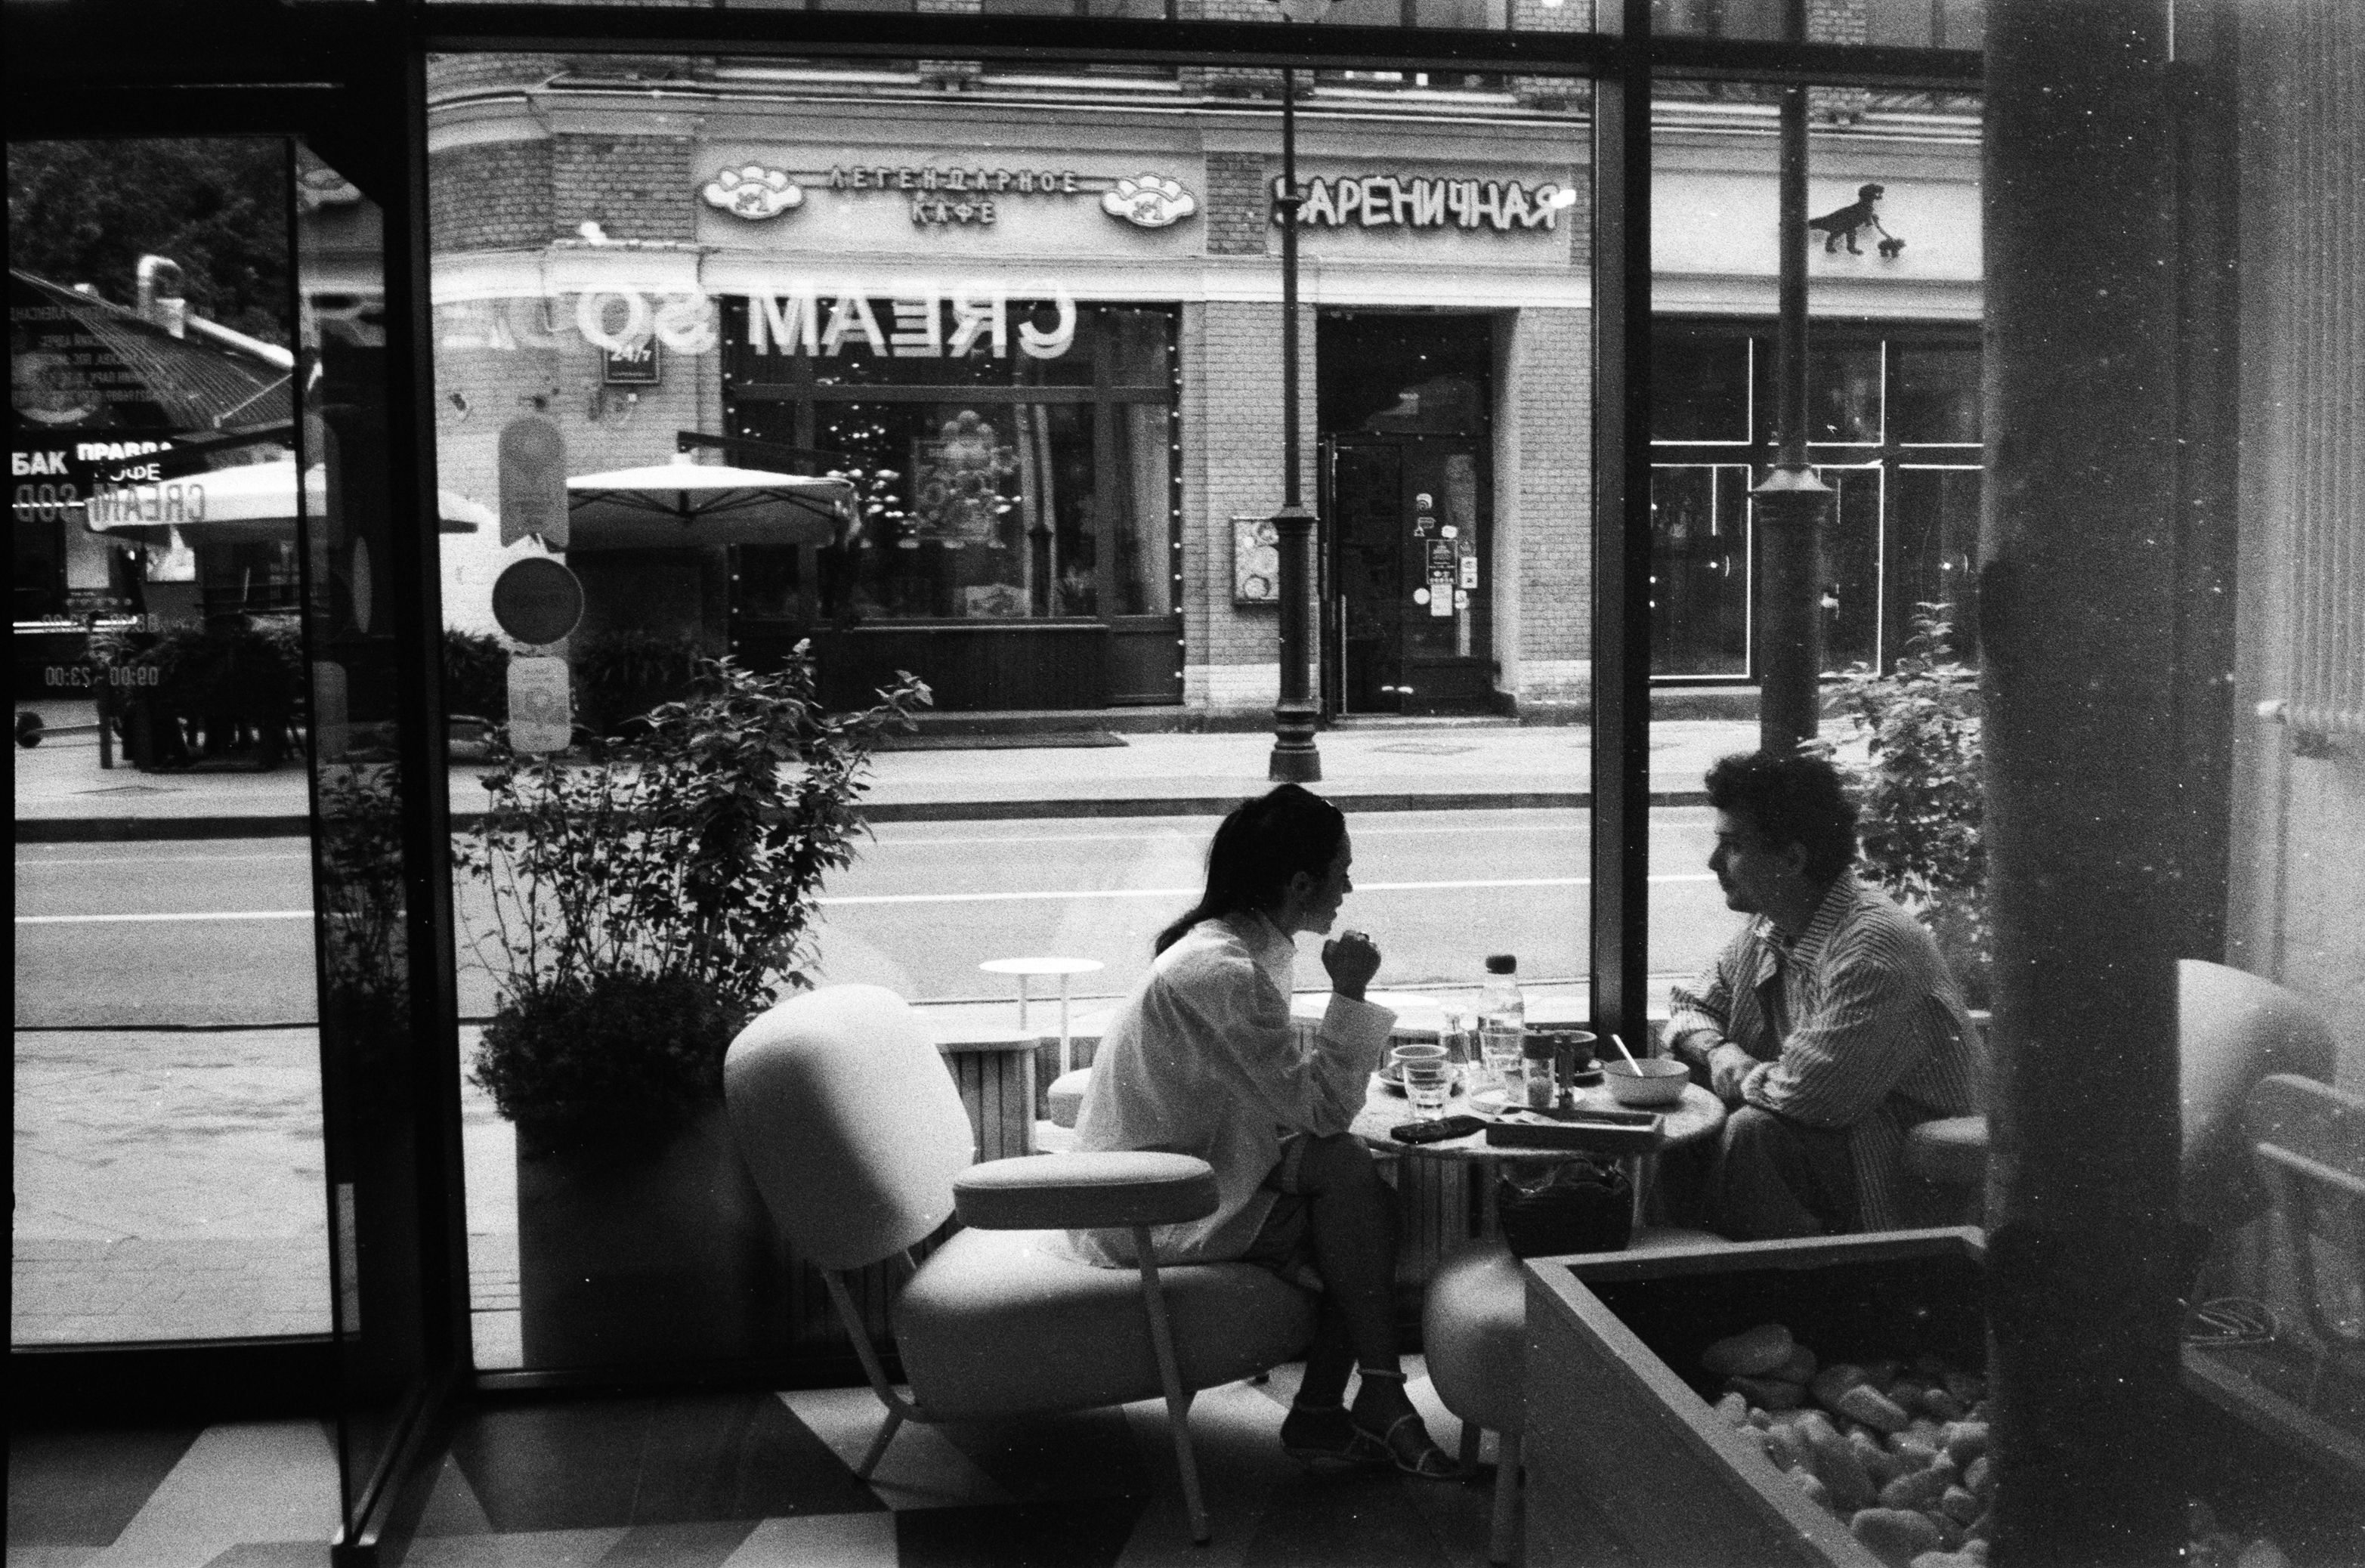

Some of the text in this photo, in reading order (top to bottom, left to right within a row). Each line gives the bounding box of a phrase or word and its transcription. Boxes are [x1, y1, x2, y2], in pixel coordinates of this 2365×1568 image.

[832, 165, 1077, 193] ЛЕГЕНДАРНОЕ
[912, 202, 996, 224] КАФЕ
[611, 345, 652, 363] 24/7
